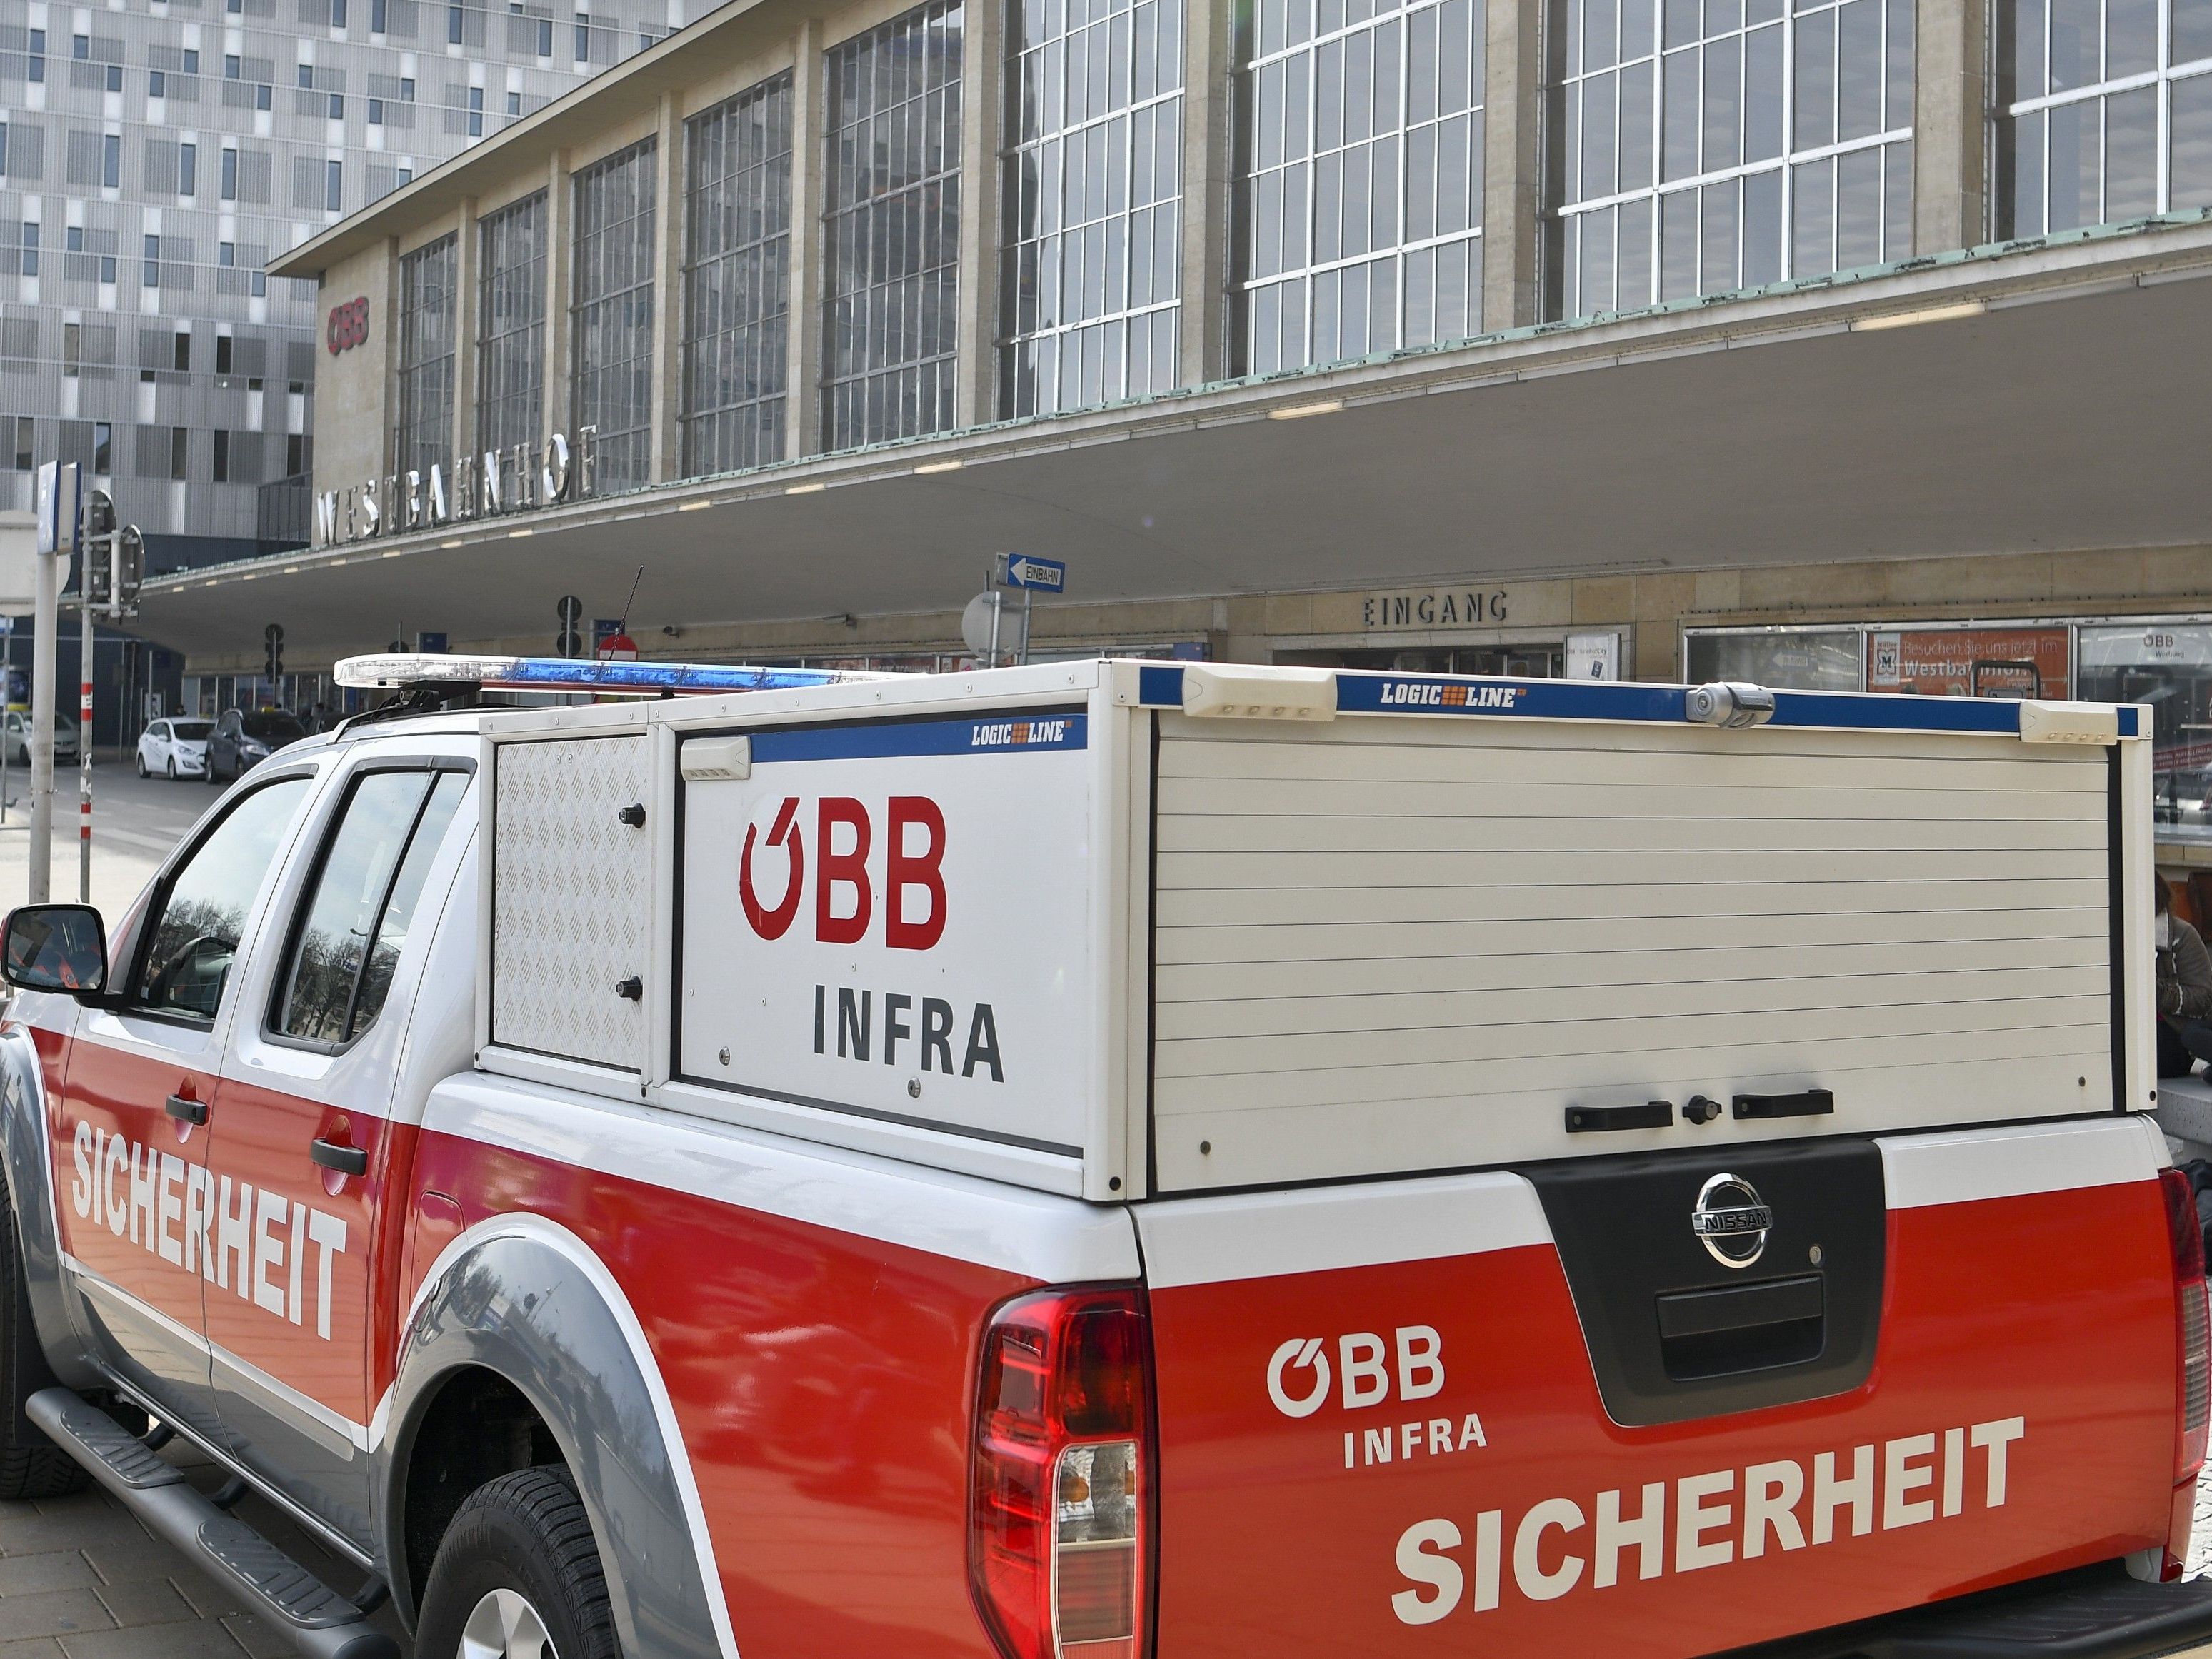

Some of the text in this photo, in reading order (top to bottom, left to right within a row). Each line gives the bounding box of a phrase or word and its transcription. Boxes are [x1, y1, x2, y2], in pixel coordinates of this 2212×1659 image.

[317, 425, 596, 545] WESTBAHNHOF
[1026, 566, 1058, 583] EINBAHN
[1364, 591, 1507, 626] EINGANG
[1904, 638, 2057, 656] Besuchen Sie uns jetzt im
[2143, 635, 2173, 647] ÖBB
[1881, 656, 1892, 668] M
[1381, 683, 1516, 708] LOGIC LINE
[971, 721, 1064, 746] LOGIC LINE
[814, 984, 1004, 1083] INFRA
[72, 1120, 347, 1341] SICHERHEIT
[1705, 1212, 1768, 1231] NISSAN
[1267, 1325, 1445, 1418] ÖBB
[1344, 1413, 1488, 1469] INFRA
[1391, 1416, 2025, 1625] SICHERHEIT
